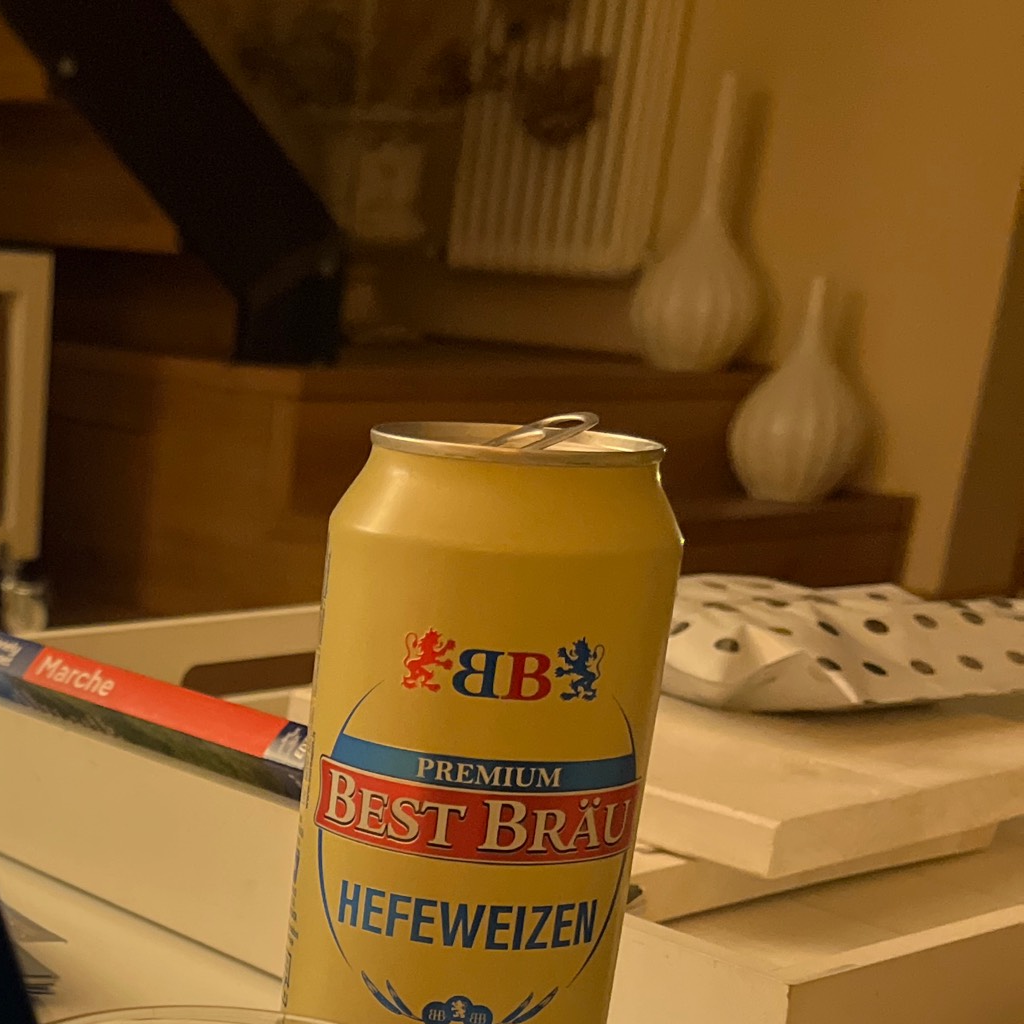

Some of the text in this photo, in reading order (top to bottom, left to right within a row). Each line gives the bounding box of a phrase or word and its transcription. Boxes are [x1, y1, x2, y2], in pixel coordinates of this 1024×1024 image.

[35, 654, 115, 697] Marche
[416, 757, 563, 788] PREMIUM
[324, 769, 467, 848] BEST
[338, 879, 598, 951] HEFEWEIZEN
